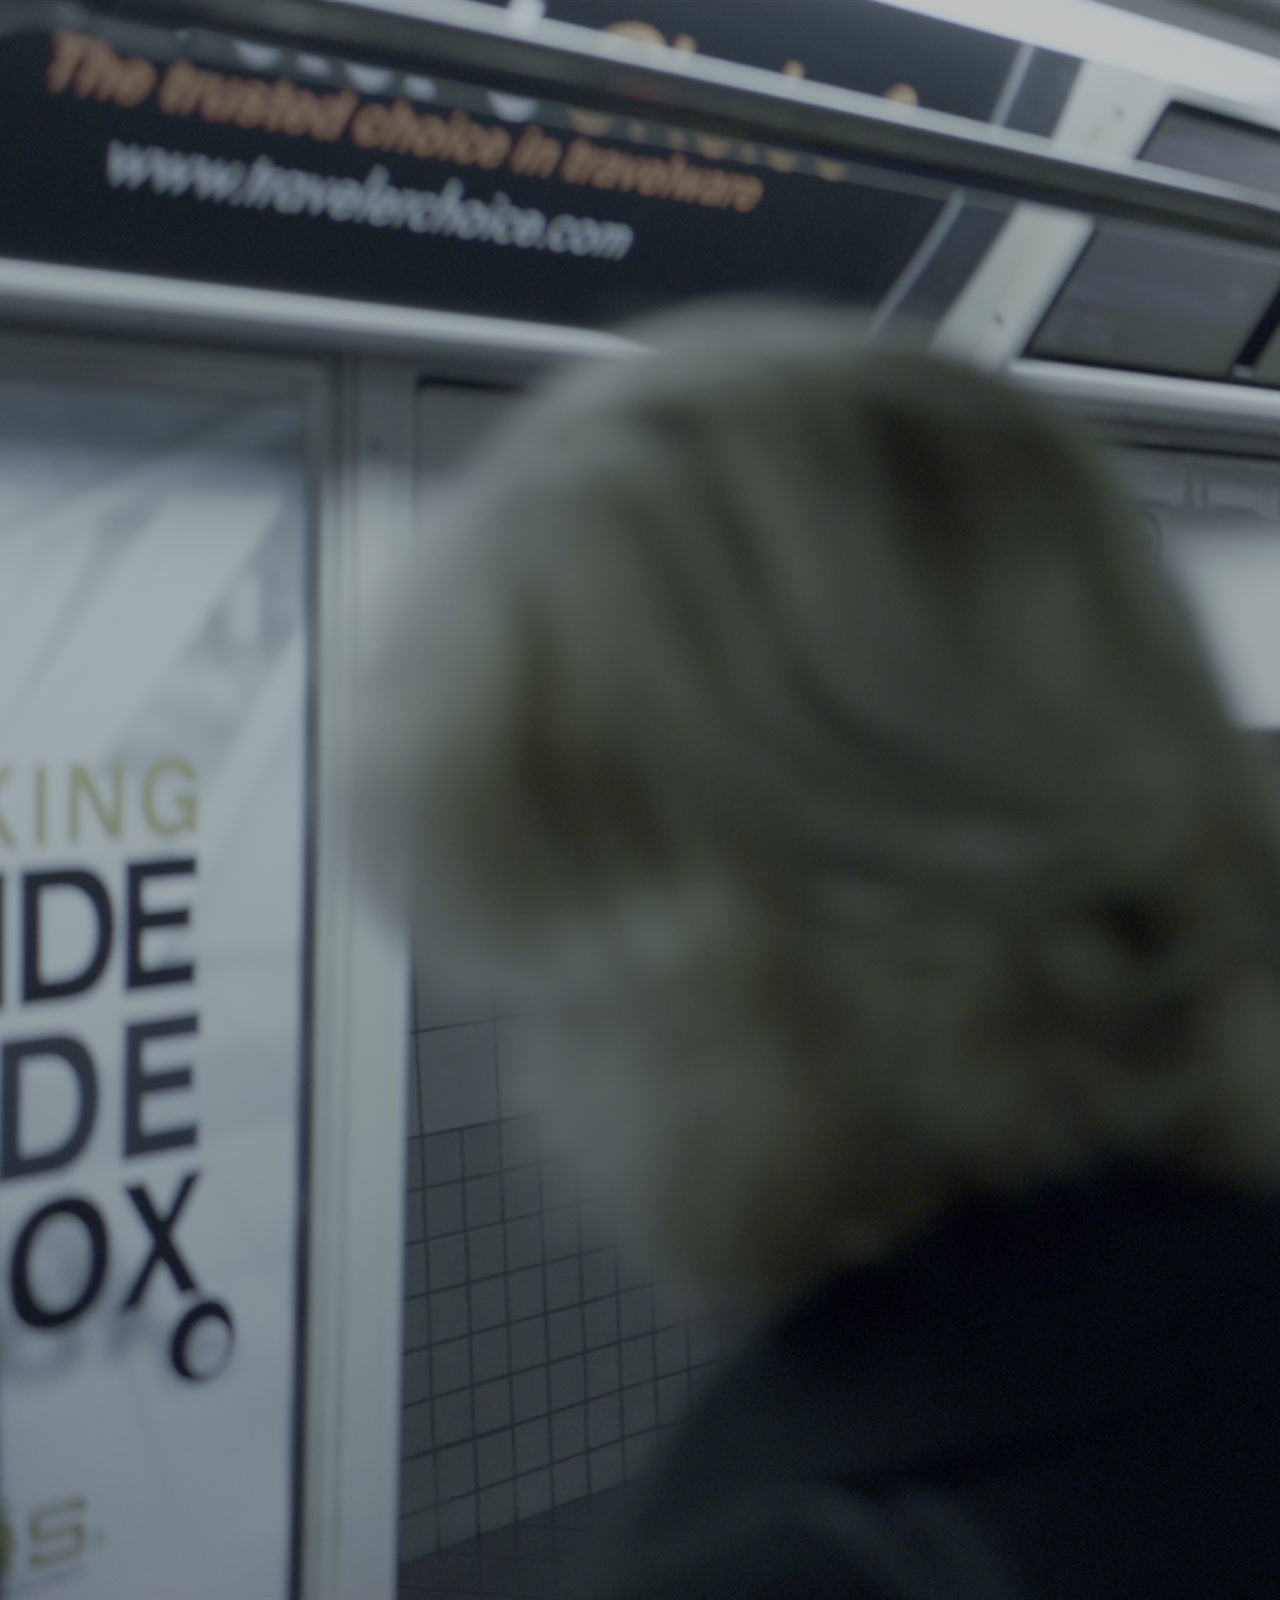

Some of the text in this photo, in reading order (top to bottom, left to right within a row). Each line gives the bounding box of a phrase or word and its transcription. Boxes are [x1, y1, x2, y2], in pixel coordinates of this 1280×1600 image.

[47, 31, 157, 108] The
[158, 57, 359, 142] trusted
[351, 97, 512, 170] choice
[507, 122, 564, 180] in
[558, 135, 766, 213] travelware
[106, 138, 635, 261] www.travelerchoice.com
